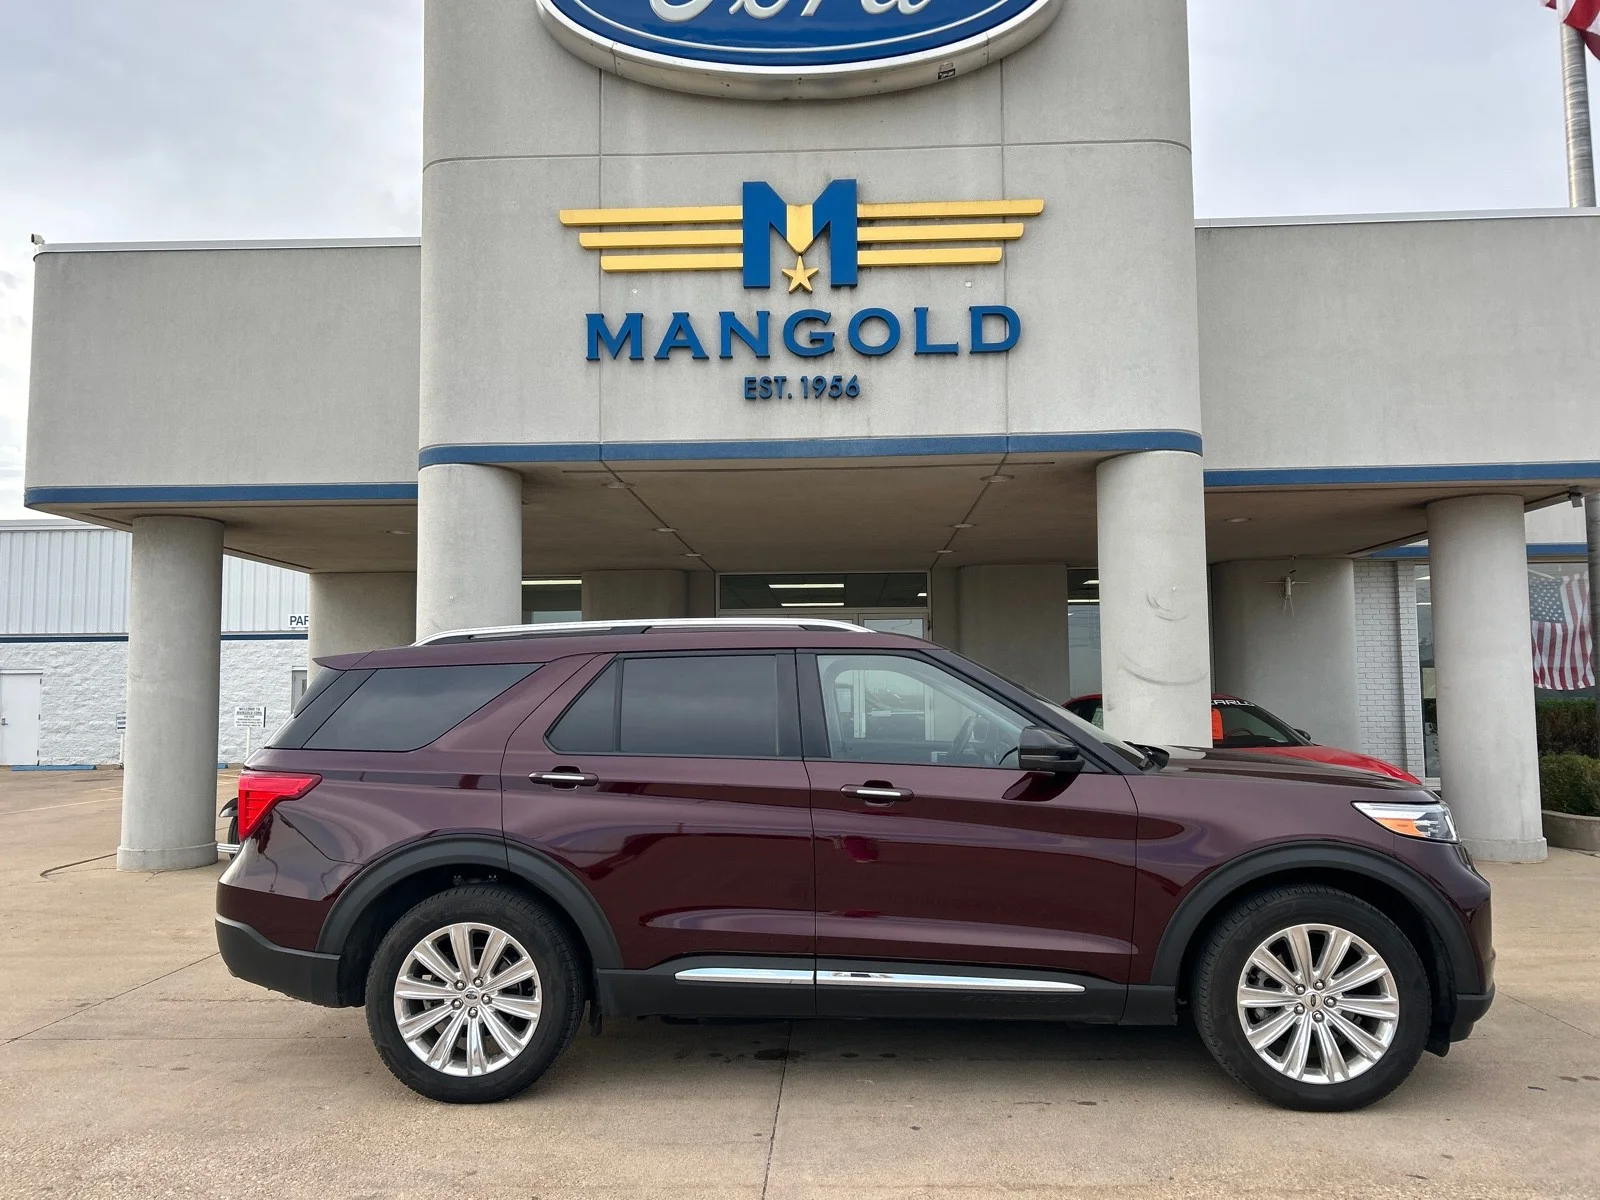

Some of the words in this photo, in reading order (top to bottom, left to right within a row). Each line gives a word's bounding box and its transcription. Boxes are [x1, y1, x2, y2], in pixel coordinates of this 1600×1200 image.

[585, 305, 1021, 361] MANGOLD
[744, 375, 793, 400] EST.
[800, 374, 860, 399] 1956
